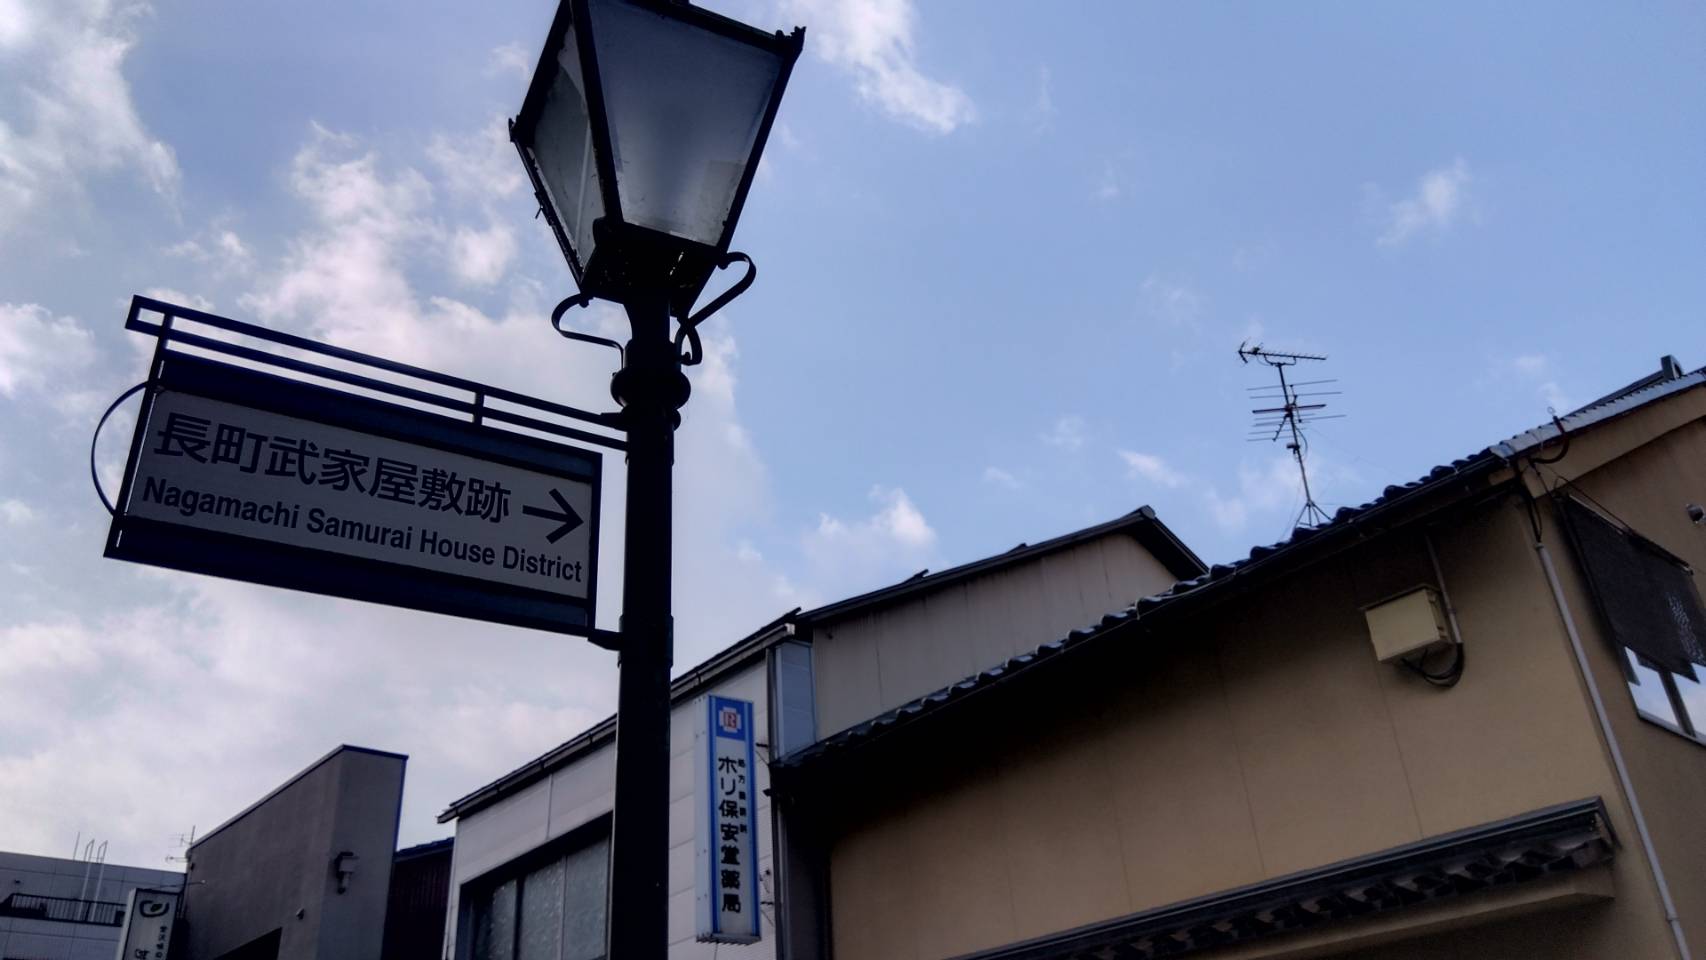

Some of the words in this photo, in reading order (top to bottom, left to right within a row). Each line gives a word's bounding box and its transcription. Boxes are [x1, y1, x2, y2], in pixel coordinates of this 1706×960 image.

[153, 412, 511, 523] 長町武家屋敷跡
[143, 476, 300, 529] Nagamachi
[306, 508, 412, 550] Samurai
[419, 529, 495, 565] House
[502, 546, 583, 583] District
[718, 756, 741, 913] ホリ保安堂薬局
